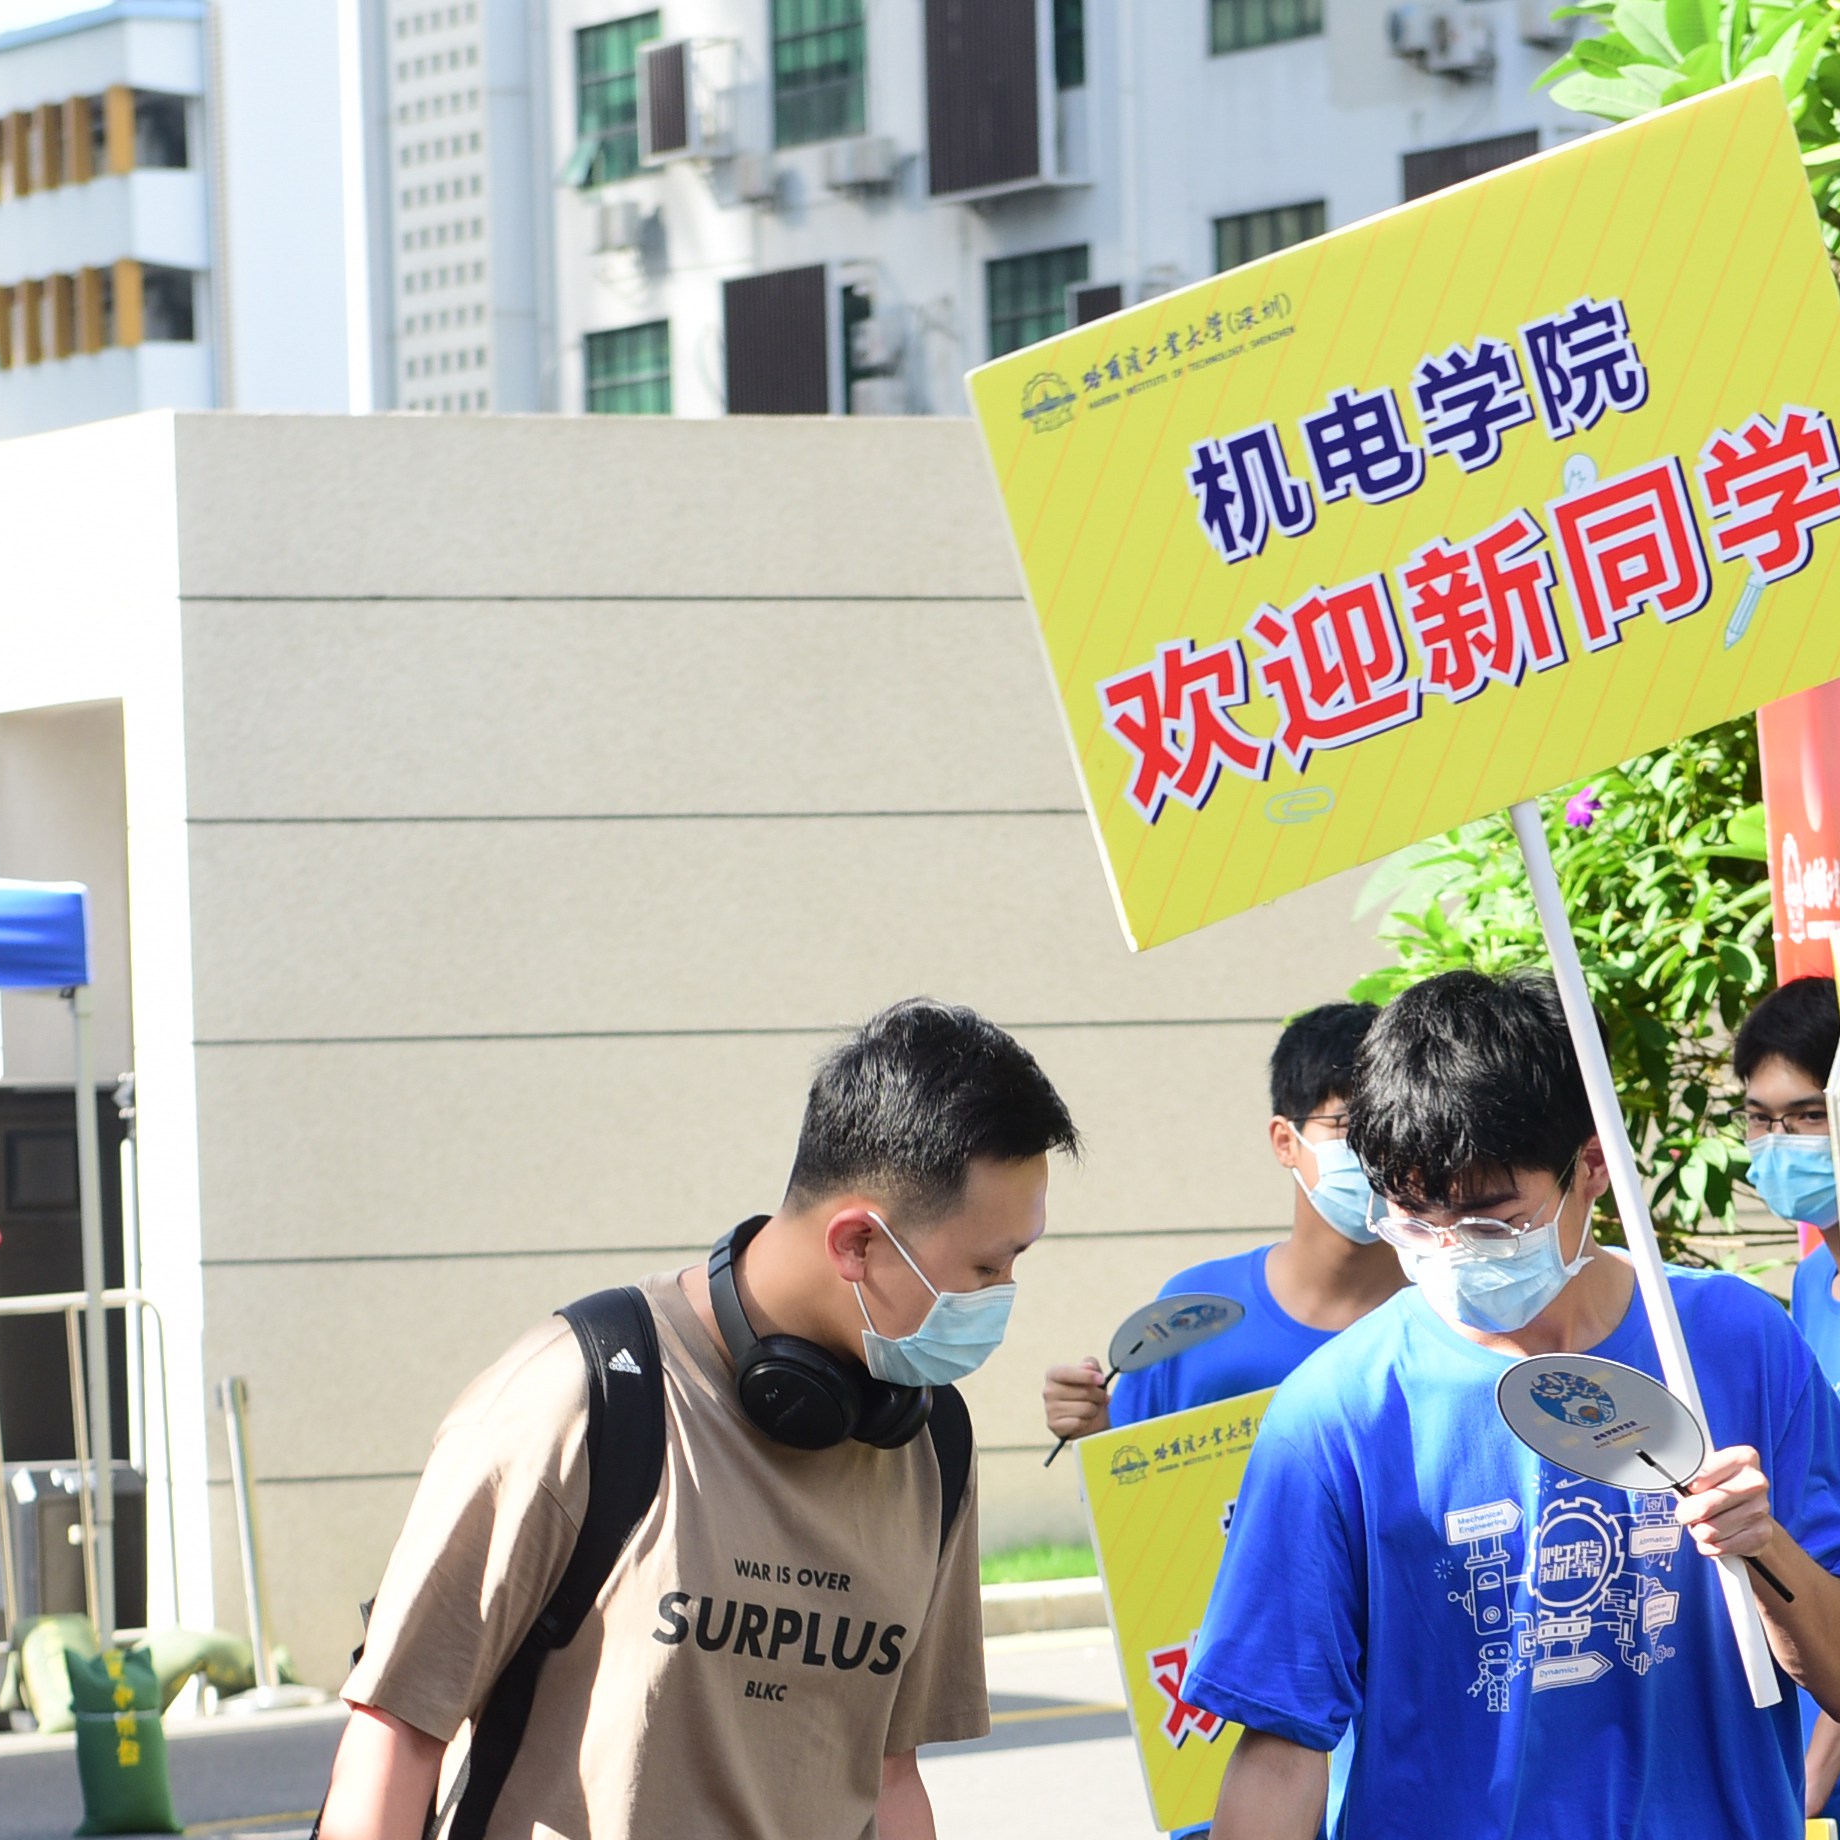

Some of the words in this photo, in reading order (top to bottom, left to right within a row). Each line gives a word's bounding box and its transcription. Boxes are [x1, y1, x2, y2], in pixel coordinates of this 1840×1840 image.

[1189, 299, 1648, 562] 机电学院
[1457, 1508, 1504, 1525] Mechanical
[1458, 1518, 1507, 1534] Engineering
[735, 1558, 771, 1582] WAR
[776, 1565, 791, 1584] IS
[798, 1568, 851, 1593] OVER
[651, 1591, 908, 1676] SURPLUS
[1540, 1666, 1579, 1678] Dynamics
[744, 1680, 788, 1702] BLKC
